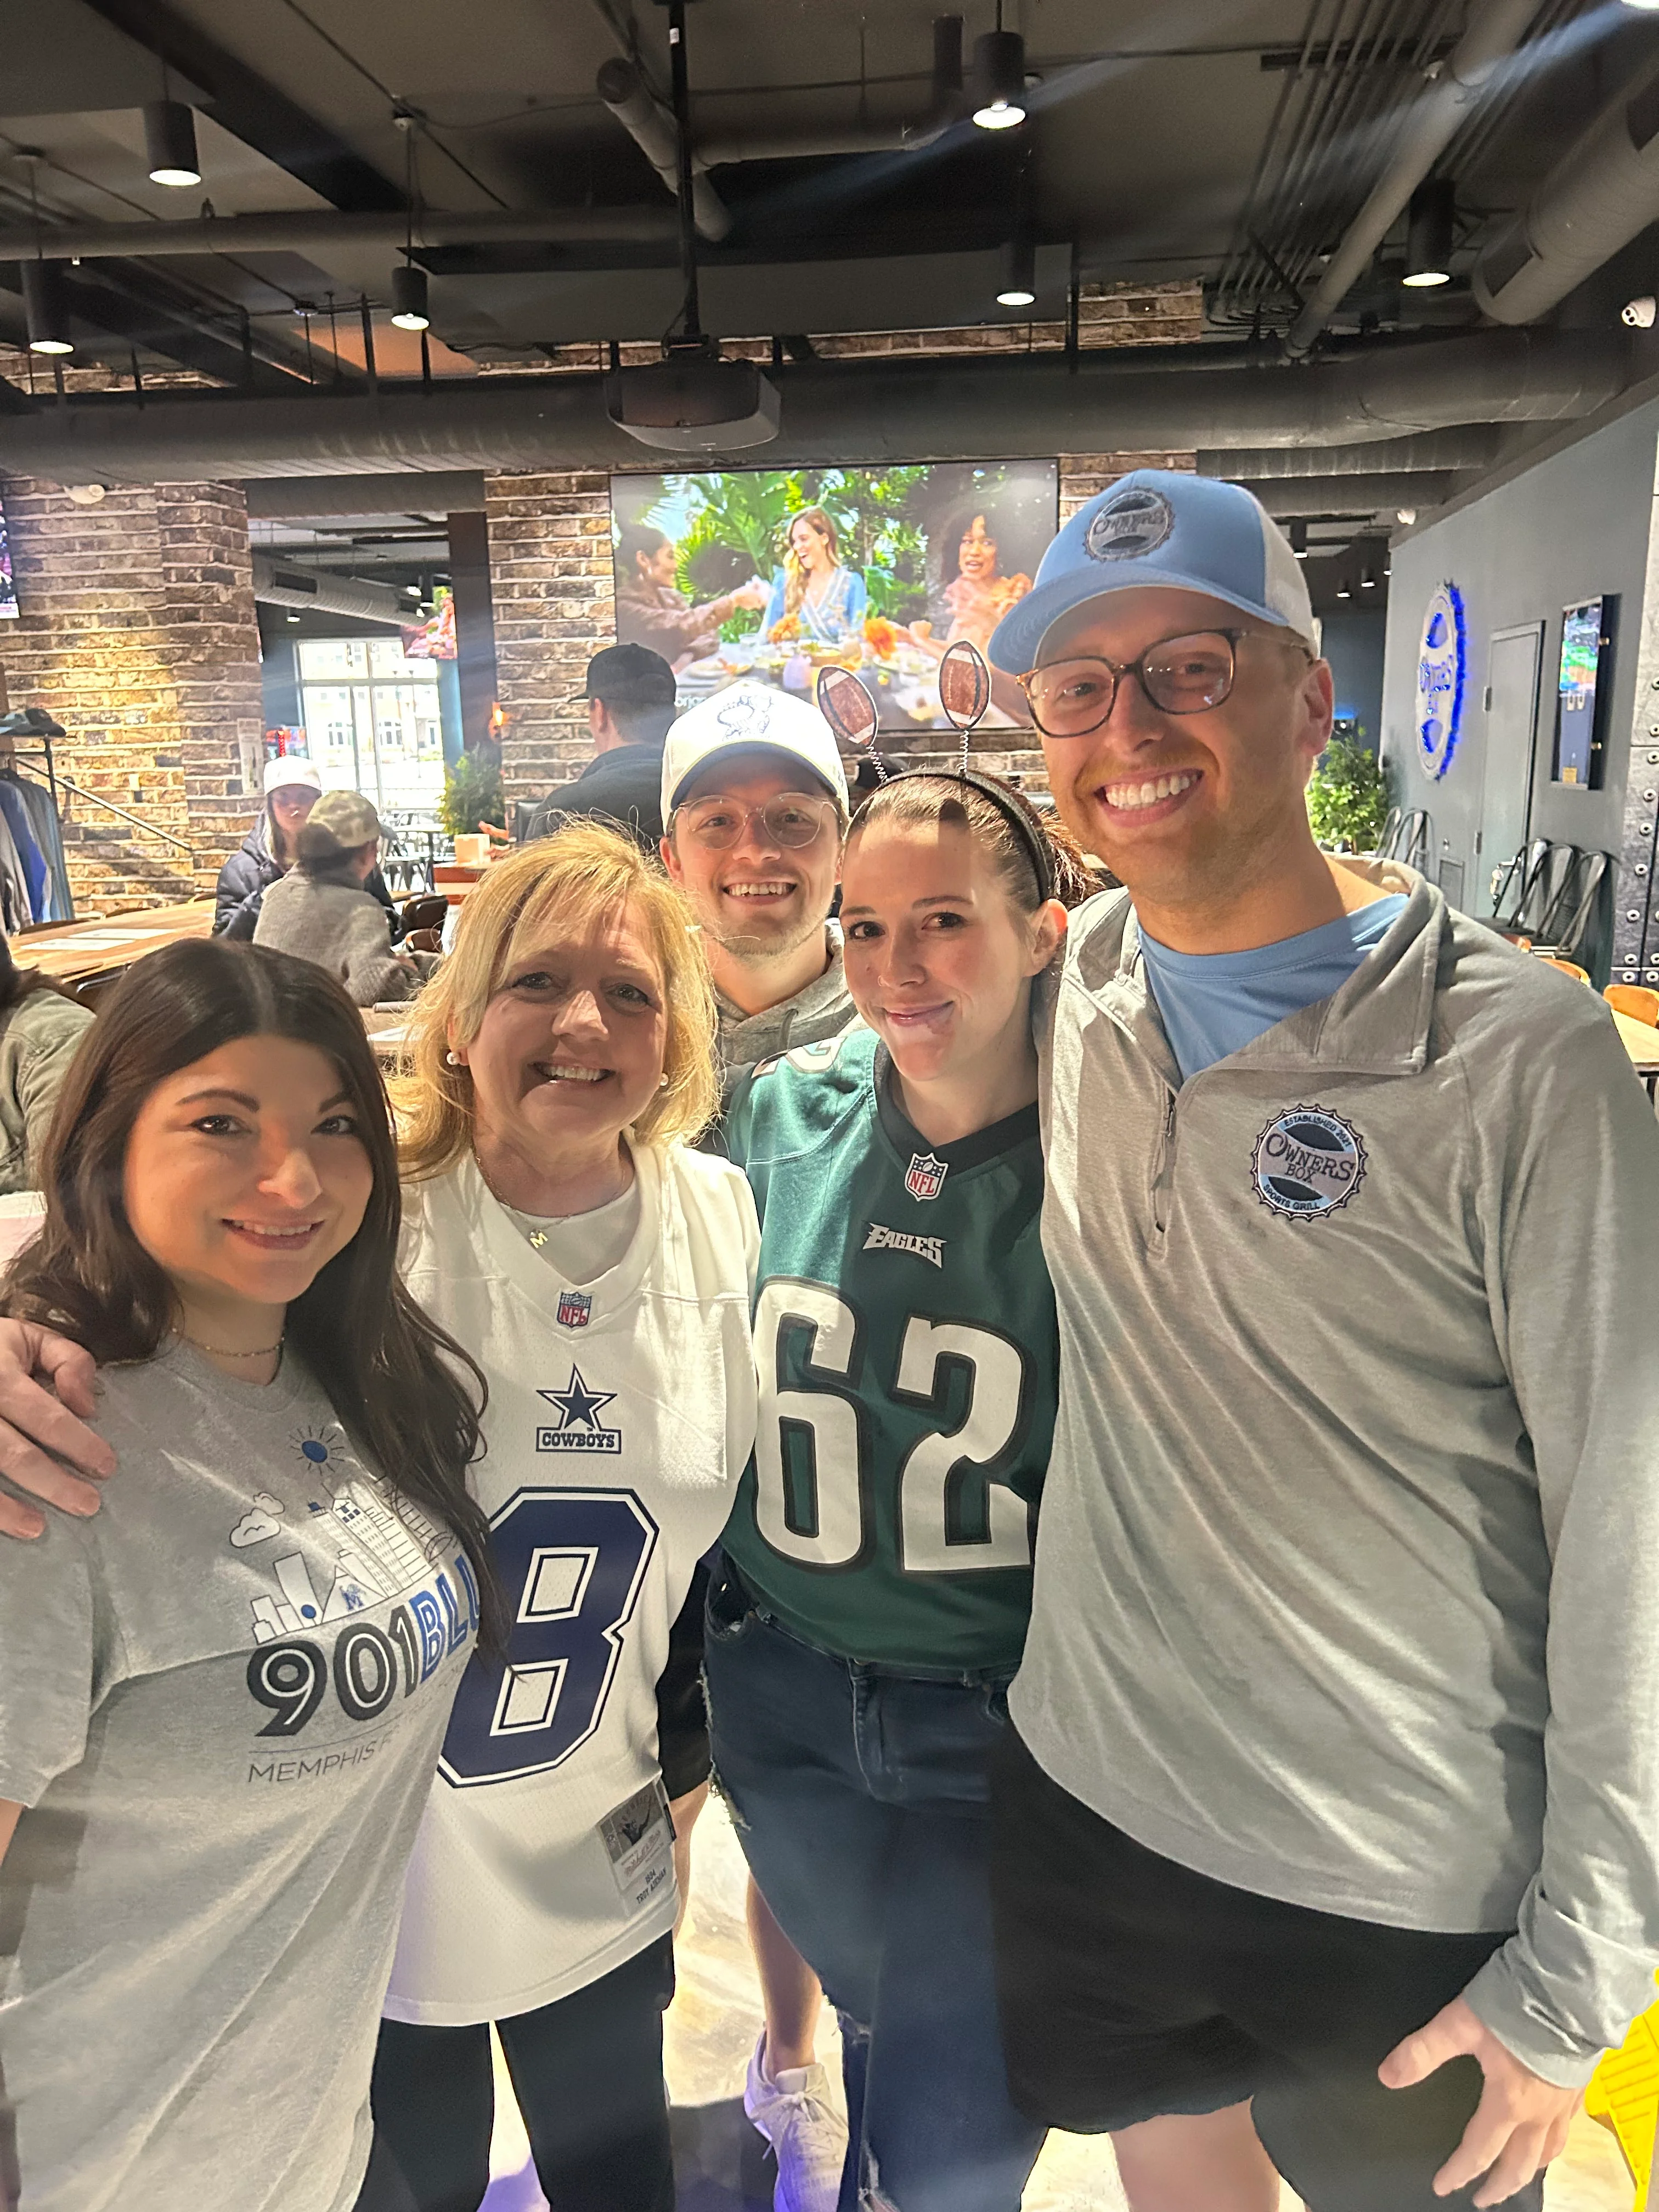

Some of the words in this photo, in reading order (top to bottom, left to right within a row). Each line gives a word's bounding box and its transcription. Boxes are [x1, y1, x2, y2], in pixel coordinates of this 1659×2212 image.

[1284, 1115, 1337, 1132] ESTABLISHED
[1336, 1128, 1352, 1148] 2021
[1266, 1133, 1356, 1181] OWNERS
[1285, 1163, 1317, 1183] BOX
[909, 1171, 936, 1194] NFL
[1263, 1184, 1290, 1209] SPORTS
[862, 1222, 948, 1268] EAGLES
[560, 1307, 589, 1325] NFL
[542, 1432, 614, 1448] COWBOYS
[752, 1280, 1031, 1571] 62
[437, 1486, 659, 1788] 8
[247, 1743, 375, 1783] MEMPHIS
